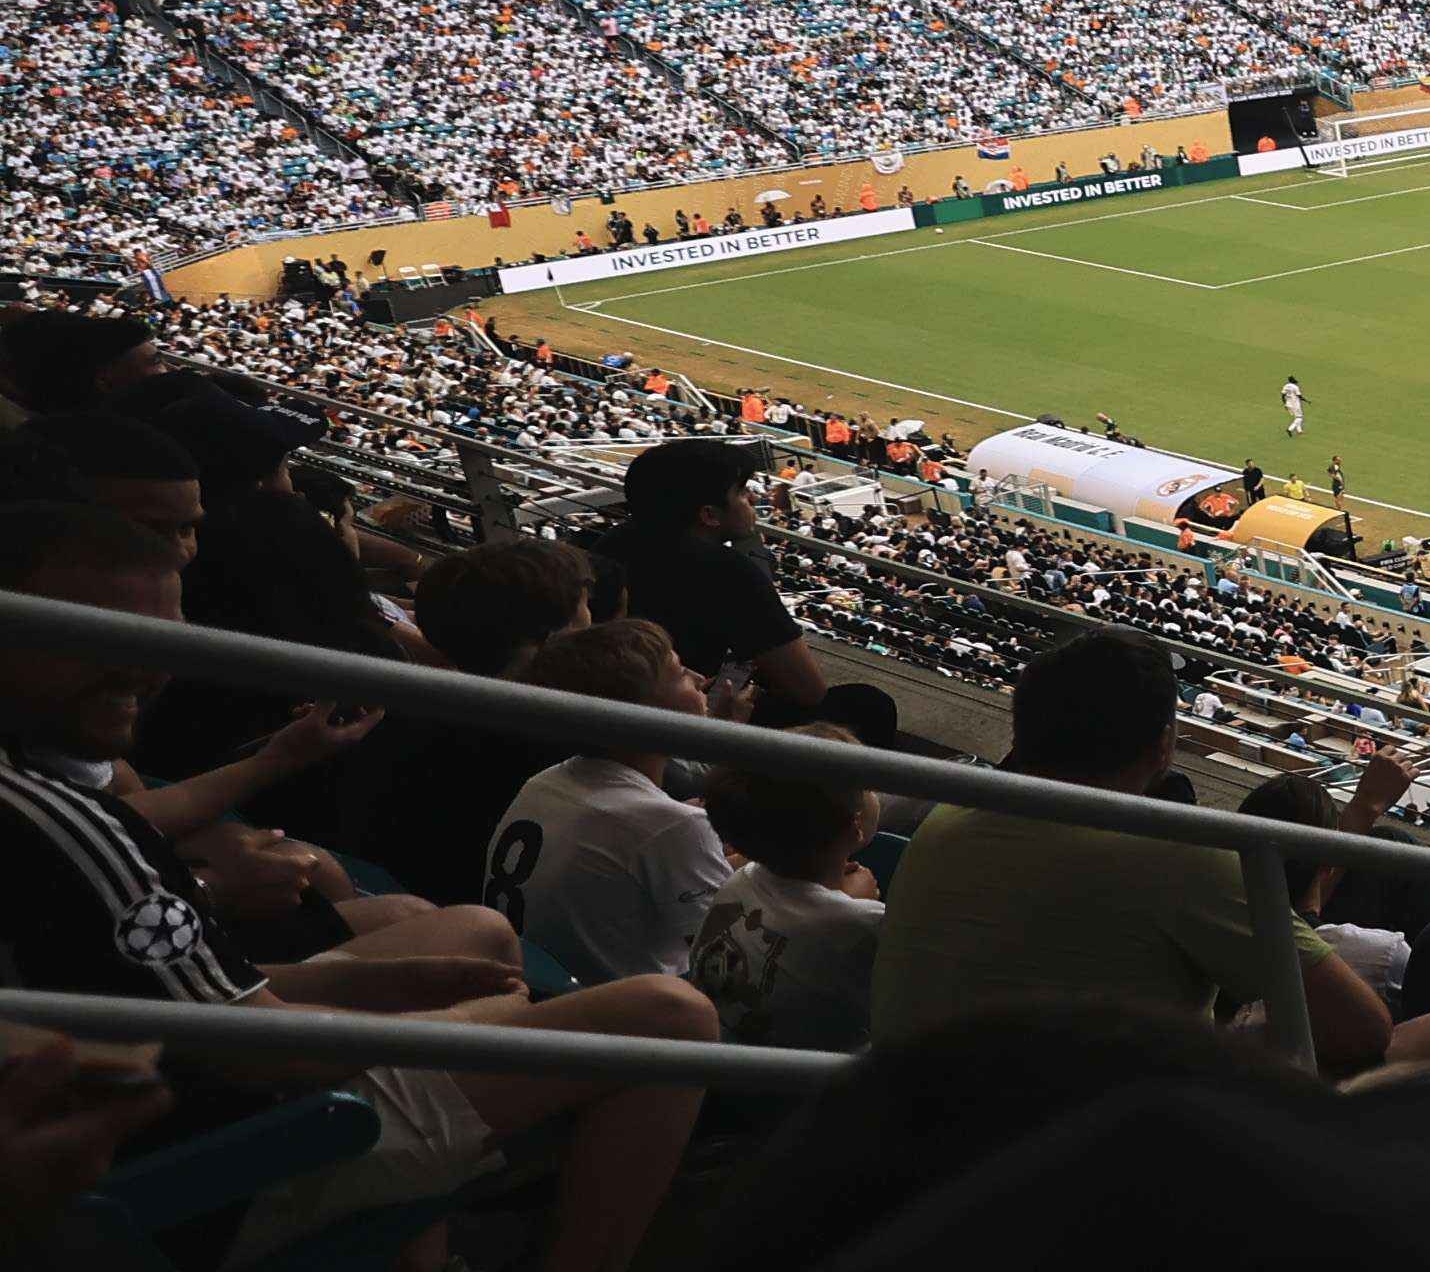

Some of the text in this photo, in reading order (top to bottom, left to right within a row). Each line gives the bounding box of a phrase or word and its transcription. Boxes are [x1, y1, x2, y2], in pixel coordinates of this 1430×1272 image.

[1310, 140, 1376, 160] INVESTED
[1380, 137, 1394, 149] IN
[1003, 175, 1161, 209] INVESTED IN BETTER
[612, 228, 819, 271] INVESTED IN BETTER
